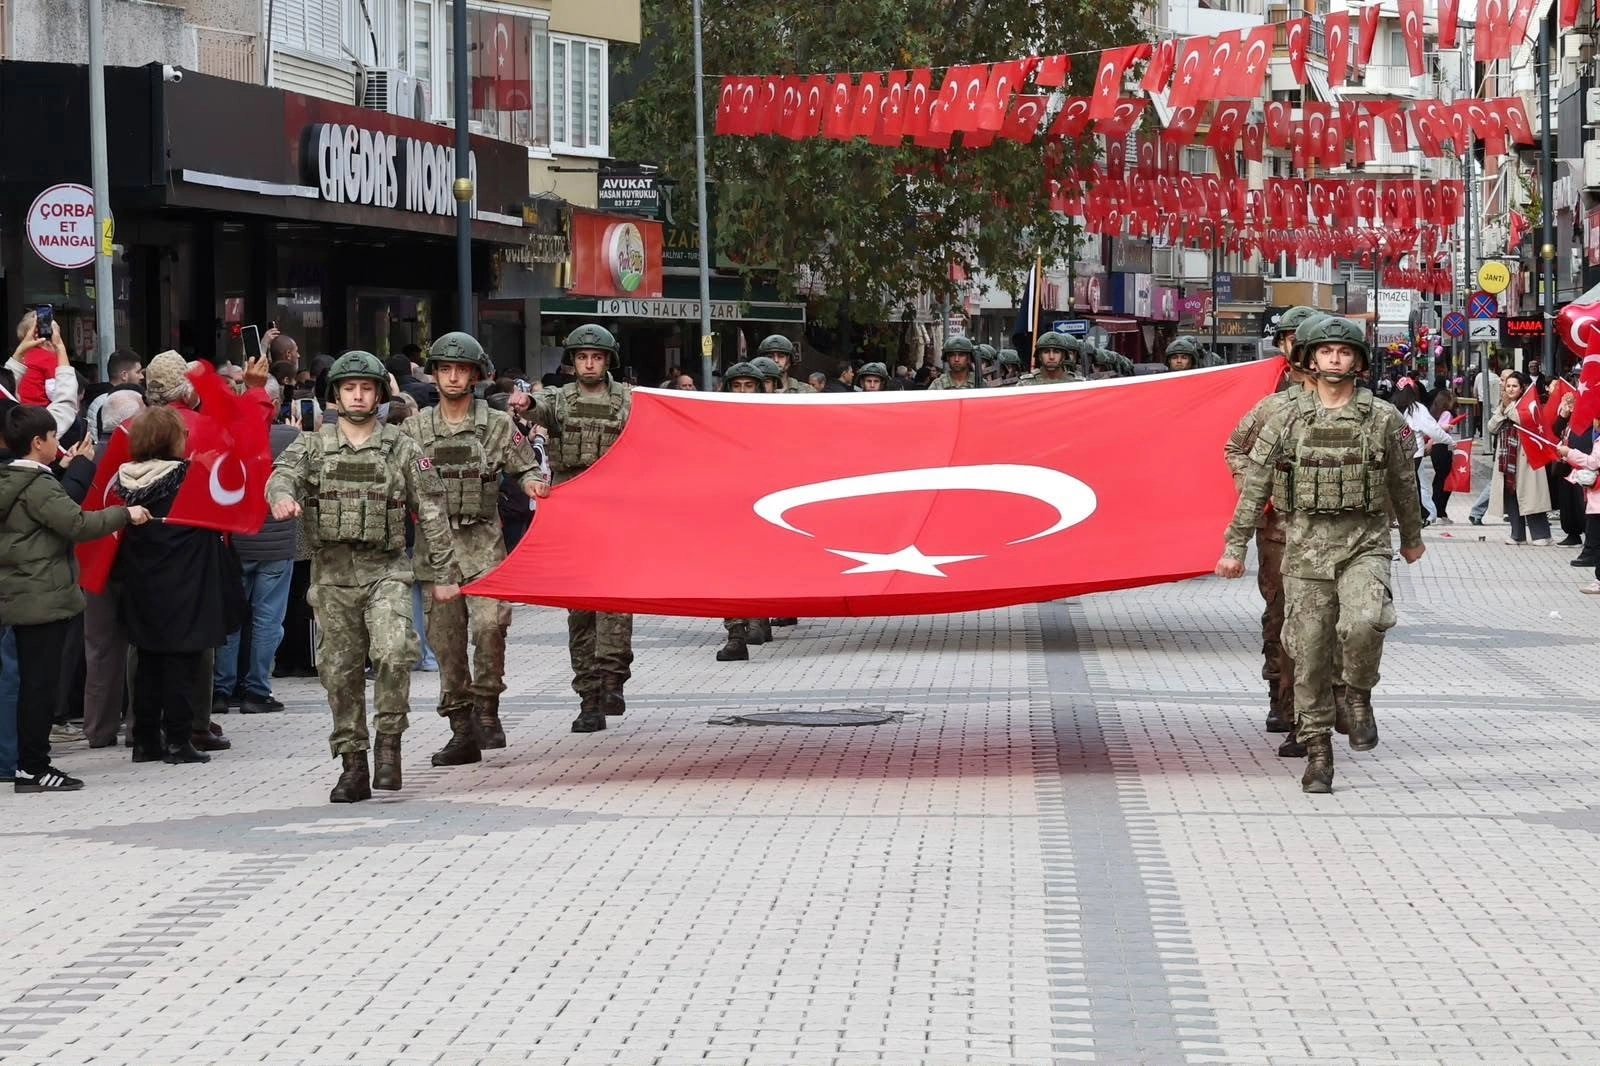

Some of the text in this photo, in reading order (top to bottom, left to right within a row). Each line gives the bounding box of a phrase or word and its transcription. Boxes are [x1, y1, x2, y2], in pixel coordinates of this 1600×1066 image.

[602, 178, 653, 189] AVUKAT
[600, 190, 657, 199] HASAN KUYRUKLU
[40, 203, 95, 220] ÇORBA
[60, 221, 77, 232] ET
[39, 235, 95, 247] MANGAL
[1367, 291, 1408, 302] MTMAZEL
[600, 300, 740, 319] LOTUS HALK PZARI
